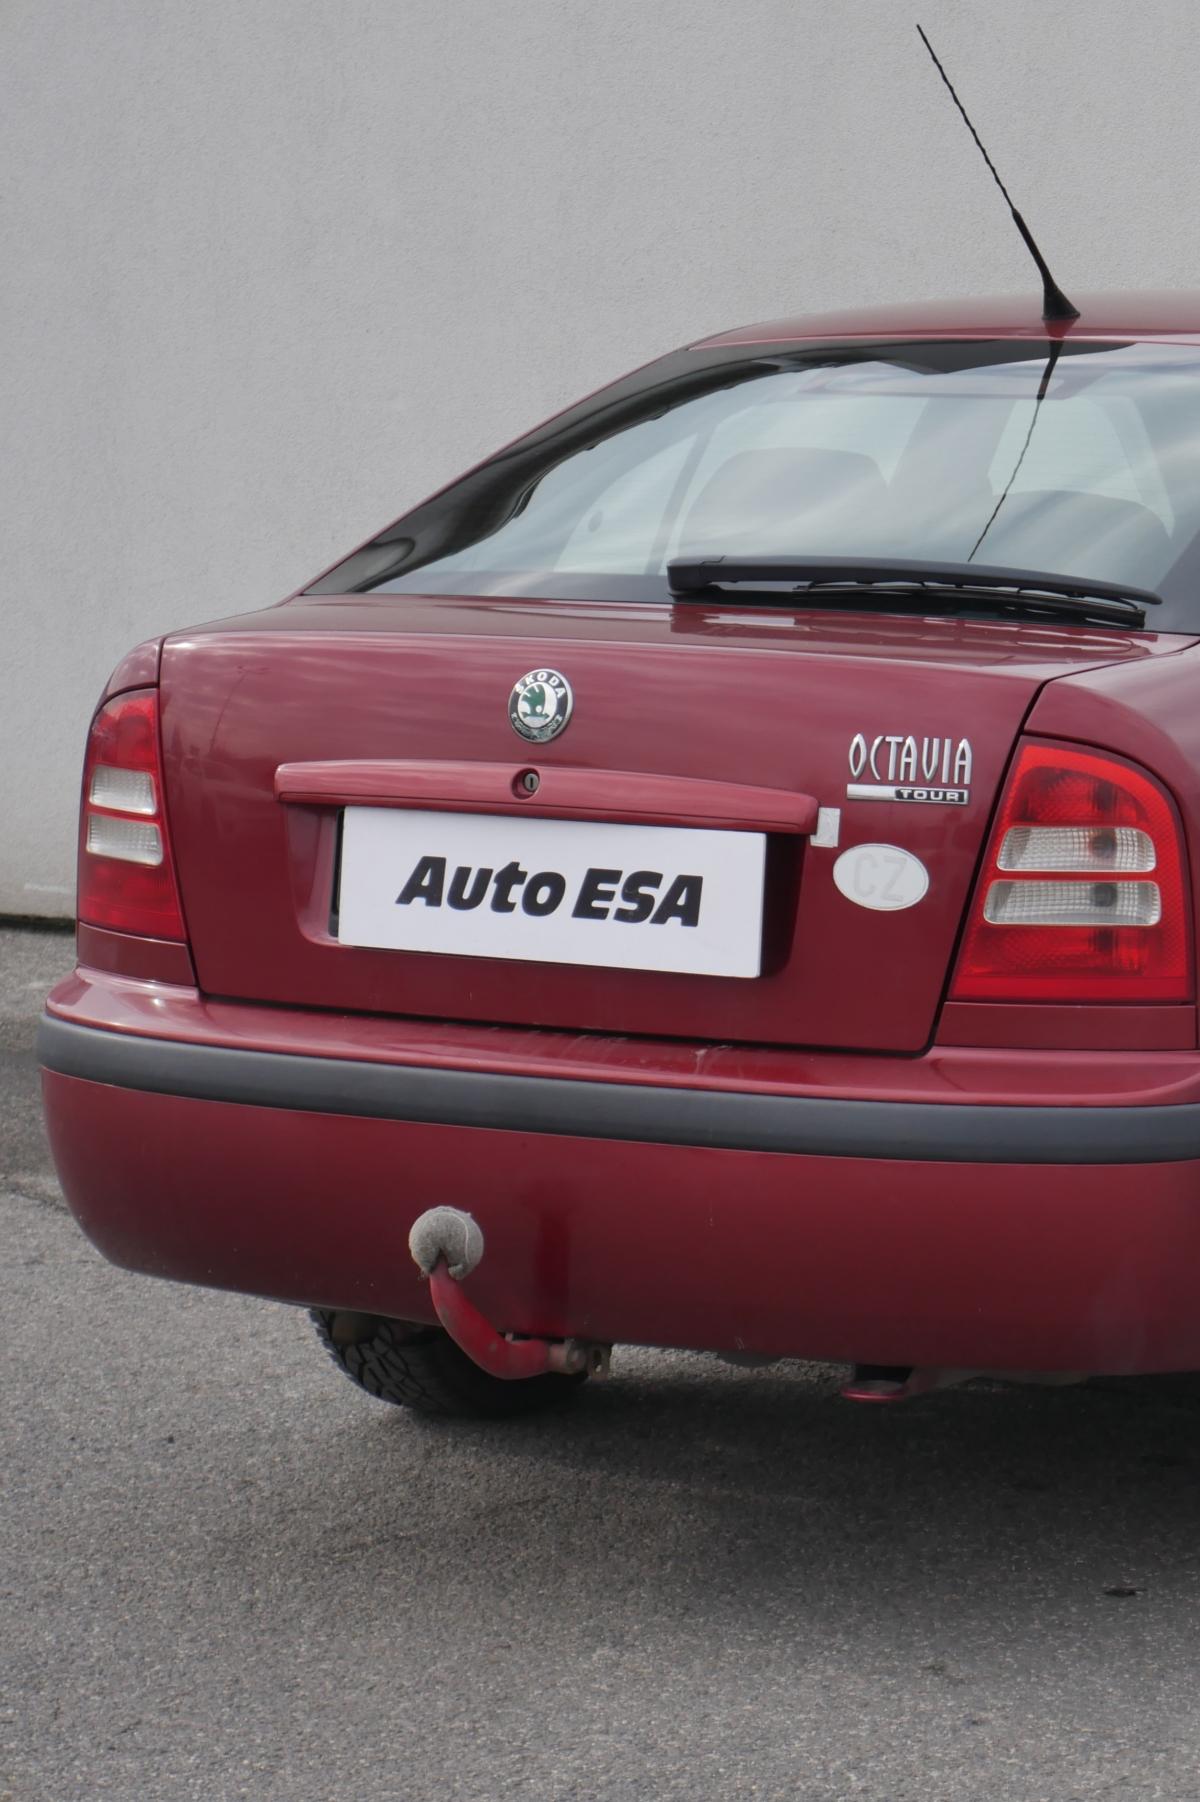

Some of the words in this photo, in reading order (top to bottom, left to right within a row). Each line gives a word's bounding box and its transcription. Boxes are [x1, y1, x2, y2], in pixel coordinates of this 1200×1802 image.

[849, 733, 973, 785] OCTAVIA
[900, 788, 959, 802] TOUR
[395, 855, 567, 917] Auto
[571, 867, 704, 928] ESA
[854, 852, 908, 902] CZ
